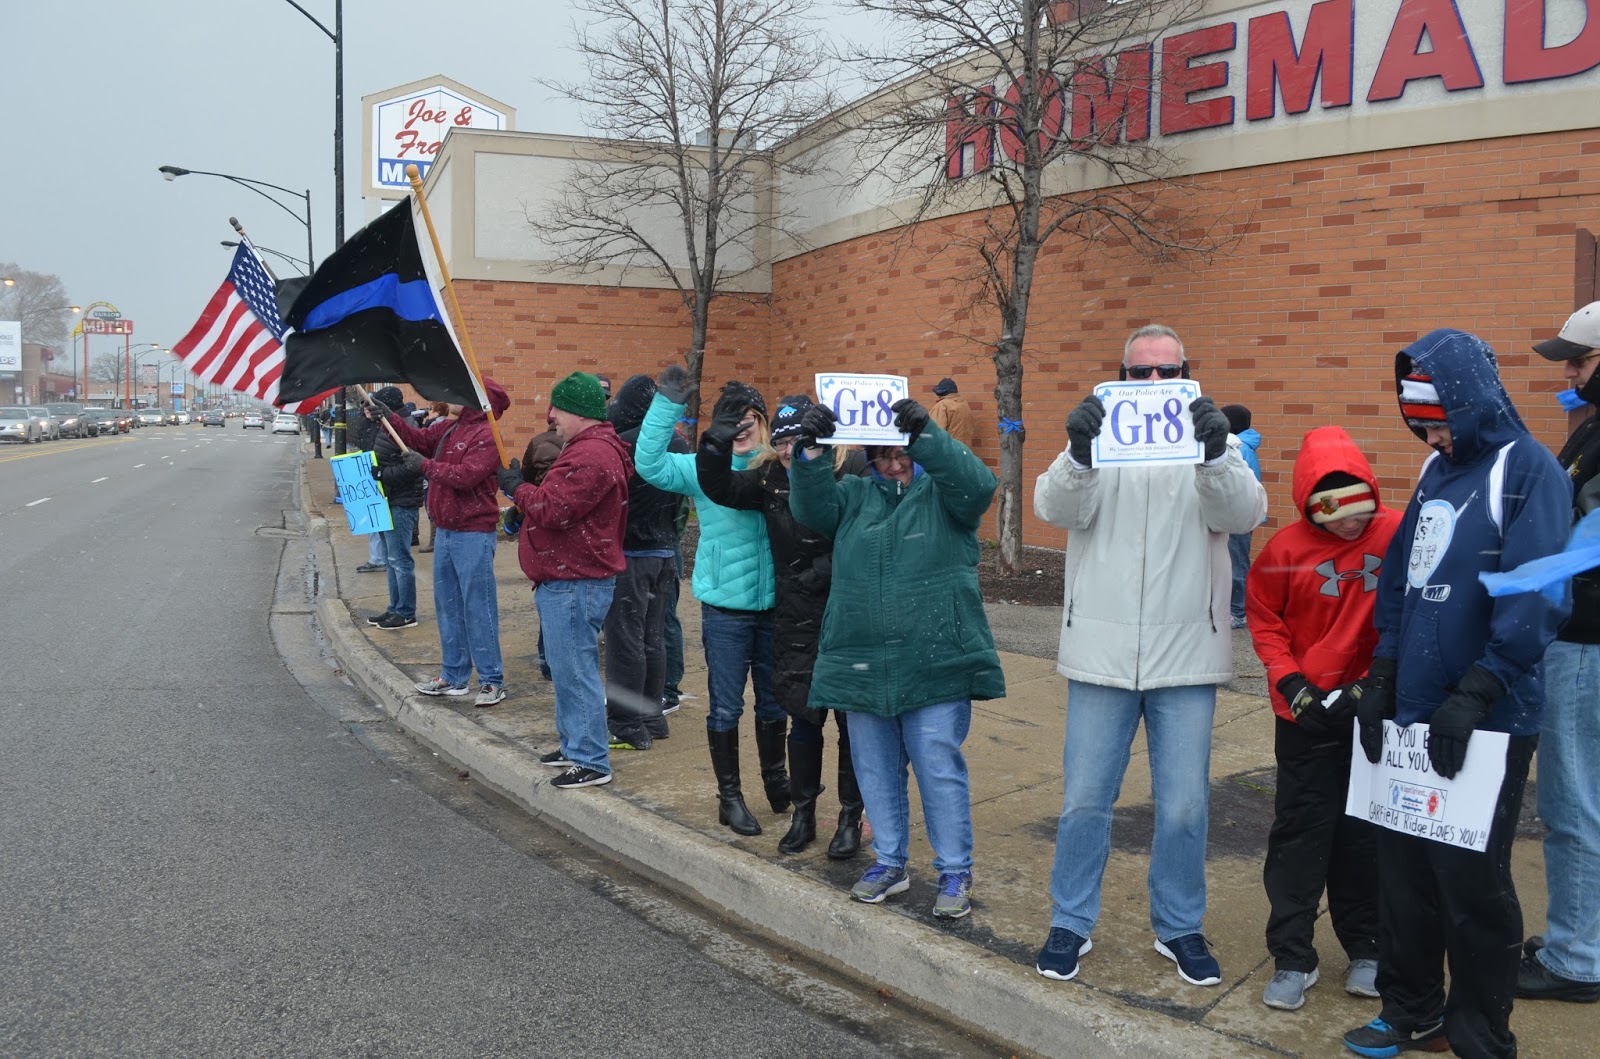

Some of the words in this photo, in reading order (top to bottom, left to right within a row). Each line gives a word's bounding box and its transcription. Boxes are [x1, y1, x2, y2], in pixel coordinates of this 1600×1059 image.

[945, 0, 1600, 178] HOMEMAD
[404, 98, 447, 130] Joe
[453, 106, 472, 126] &
[1118, 389, 1133, 397] Our
[833, 387, 893, 428] Gr8
[1111, 397, 1184, 446] Gr8
[366, 502, 382, 529] IT
[1396, 727, 1417, 748] YOU
[1386, 750, 1404, 769] ALL
[1408, 750, 1430, 773] YOU
[1429, 821, 1456, 842] LOVES
